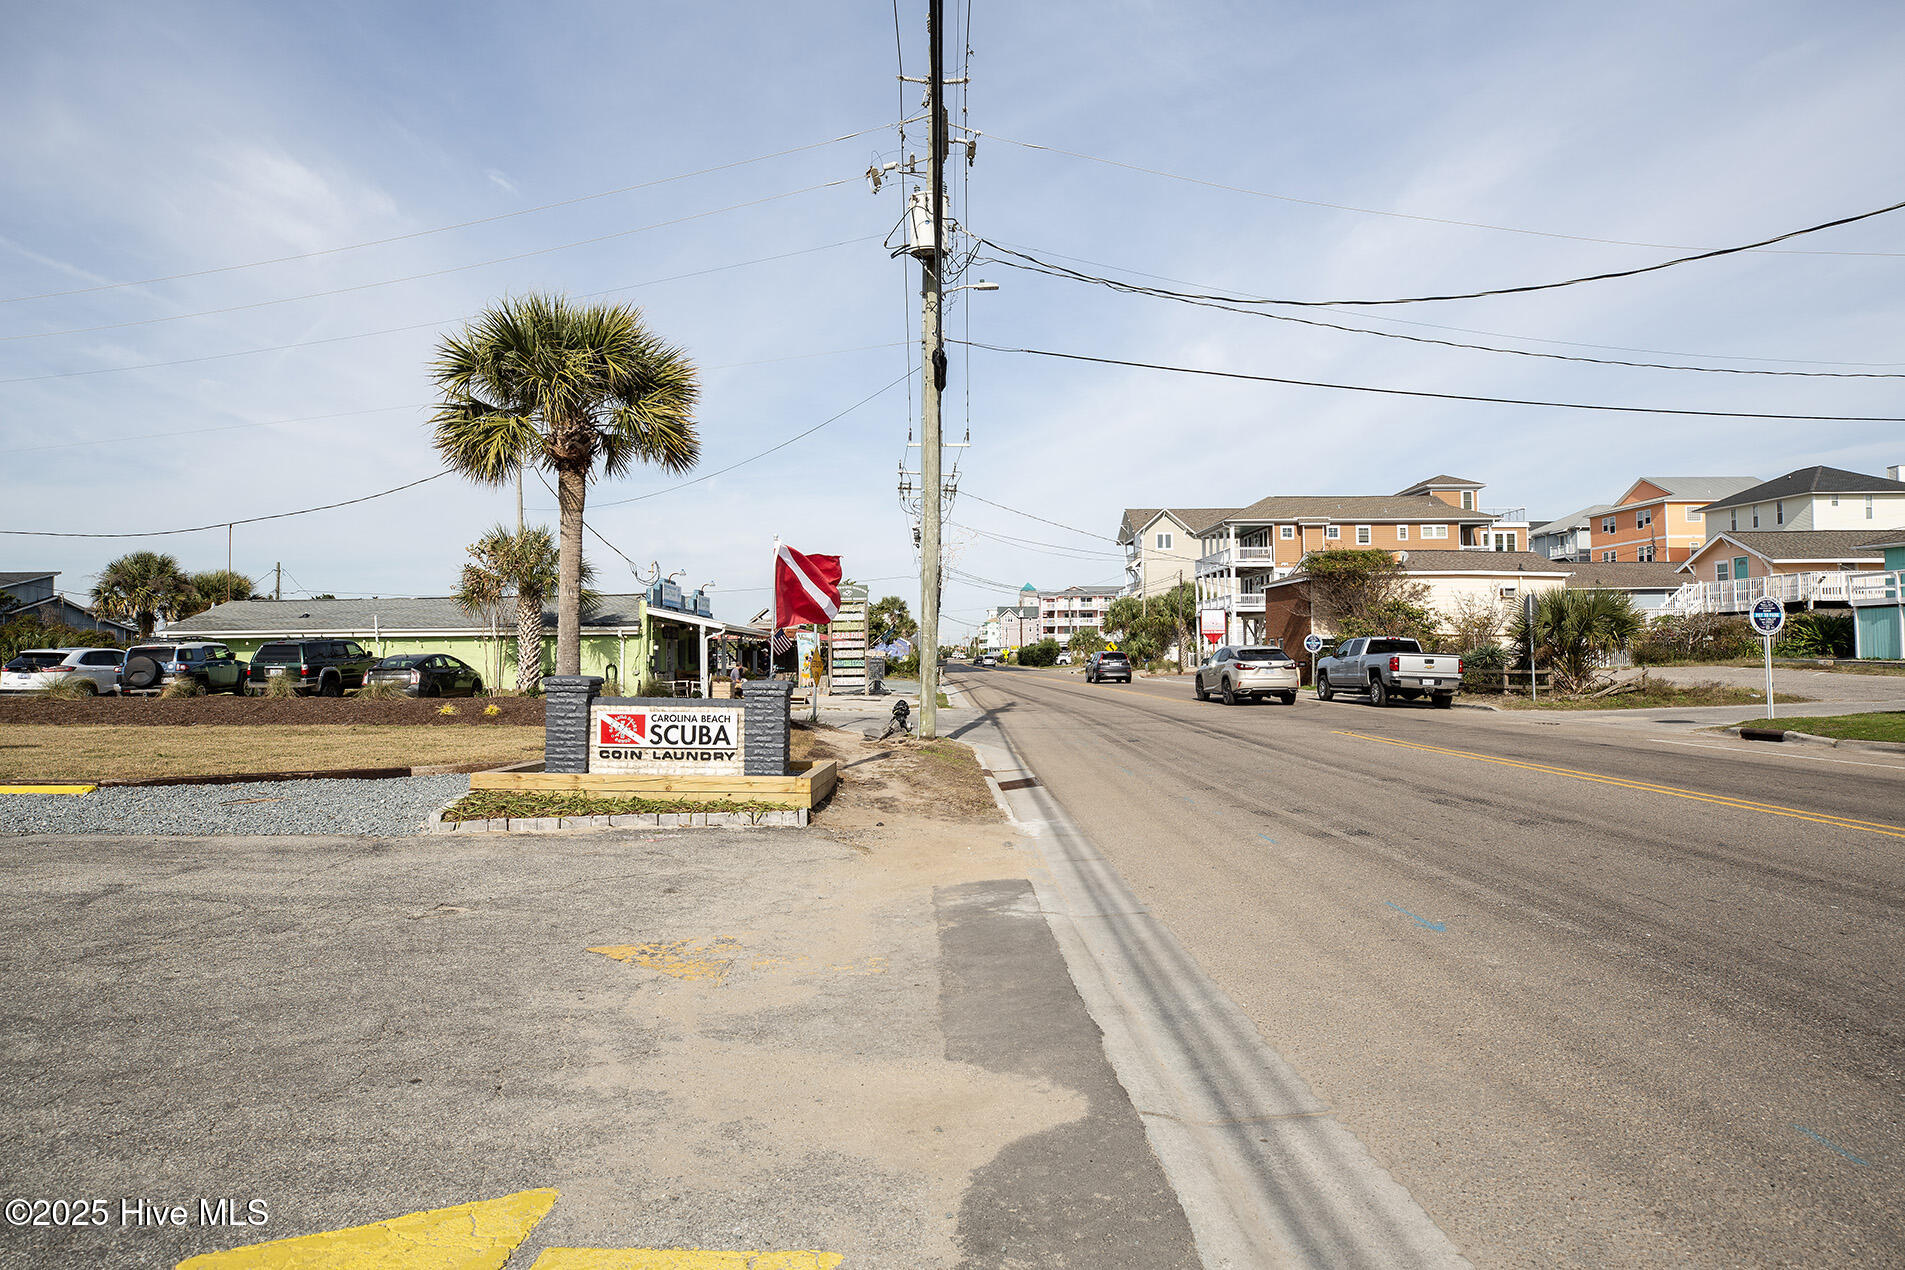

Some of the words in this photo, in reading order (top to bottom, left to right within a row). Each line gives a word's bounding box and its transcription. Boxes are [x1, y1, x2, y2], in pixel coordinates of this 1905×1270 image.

[651, 714, 698, 724] CAROLINA
[701, 714, 731, 724] BEACH
[649, 724, 731, 746] SCUBA
[599, 750, 643, 760] COIN
[652, 750, 736, 762] LAUNDRY
